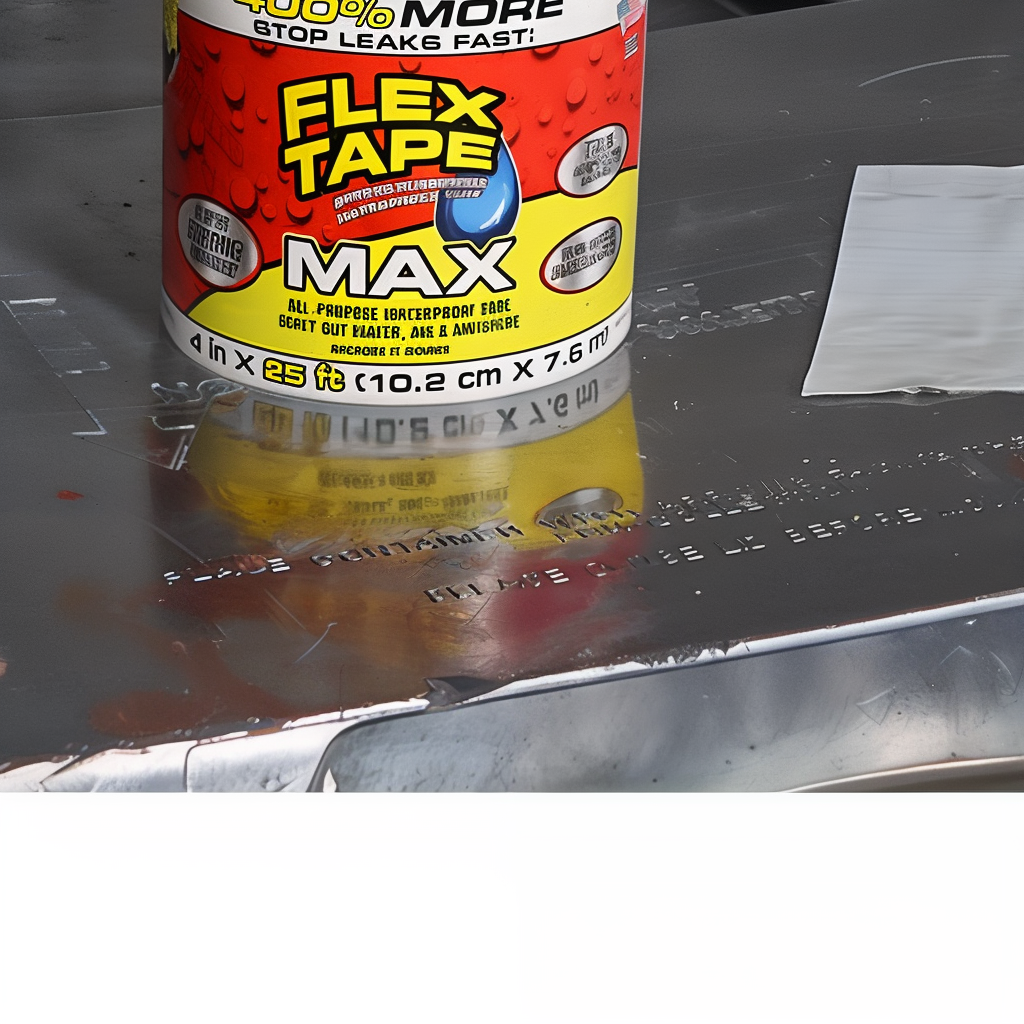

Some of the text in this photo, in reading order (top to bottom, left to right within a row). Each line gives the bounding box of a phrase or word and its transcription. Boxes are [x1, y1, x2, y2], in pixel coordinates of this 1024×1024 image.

[281, 75, 503, 143] FLEX
[282, 127, 500, 197] TAPE
[285, 236, 517, 298] MAX
[208, 336, 227, 366] in
[263, 357, 307, 388] 25
[314, 361, 346, 393] ft
[354, 372, 446, 393] (10.2
[458, 367, 501, 390] cm
[543, 342, 583, 373] 7.6
